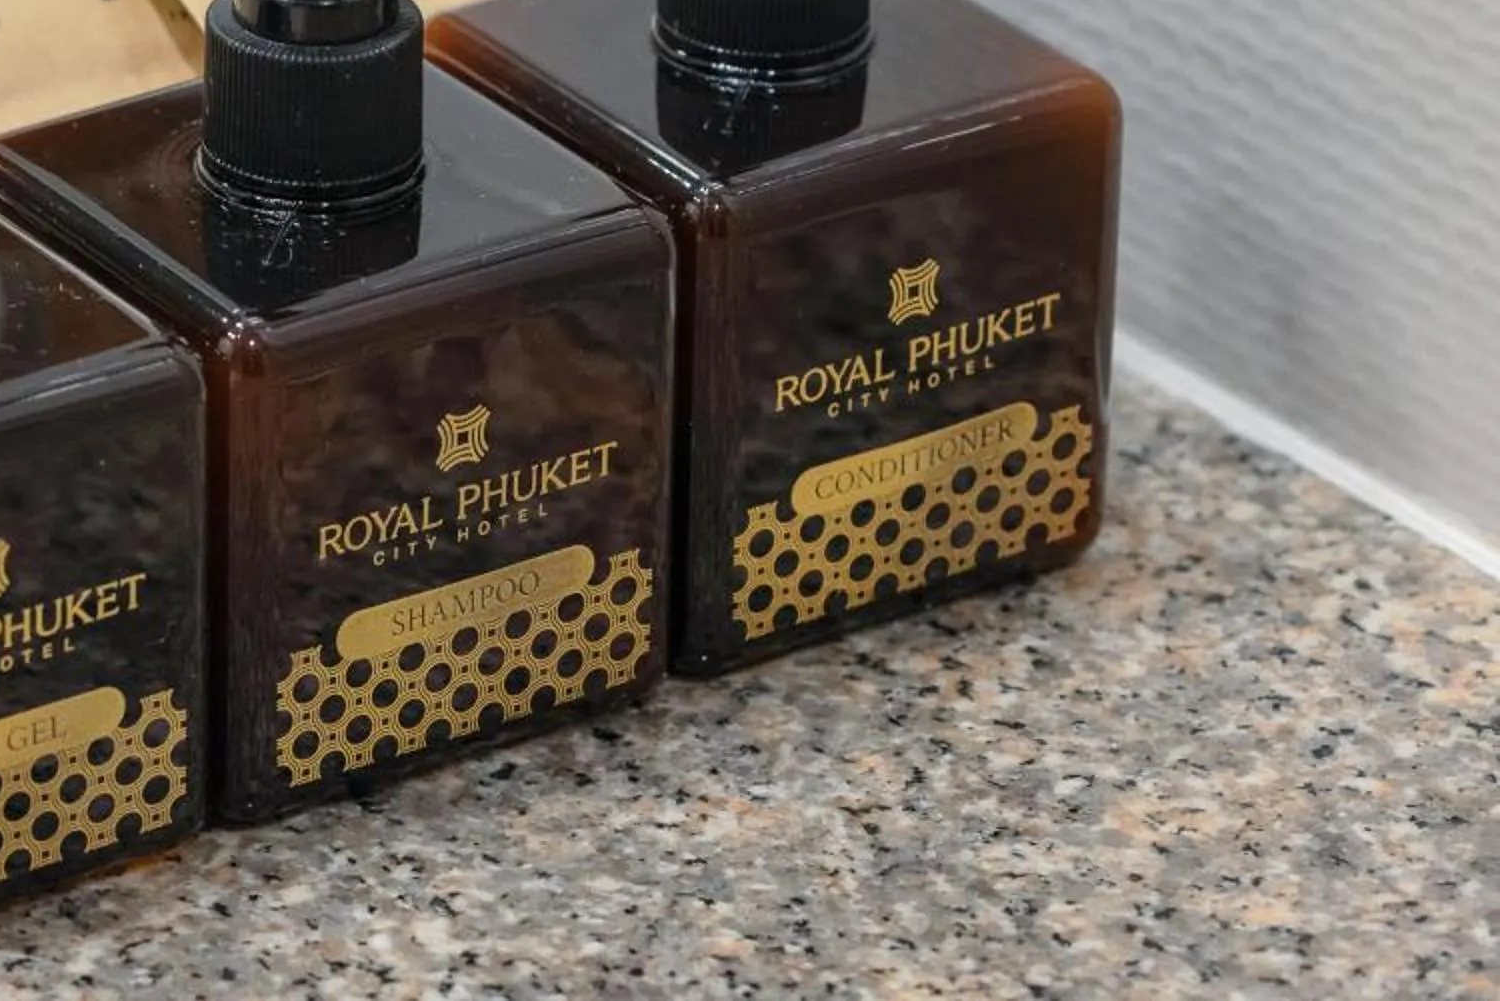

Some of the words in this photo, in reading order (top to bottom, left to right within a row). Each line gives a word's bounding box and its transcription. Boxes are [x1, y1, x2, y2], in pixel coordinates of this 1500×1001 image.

[774, 349, 897, 412] ROYAL
[908, 293, 1062, 372] PHUKET
[827, 388, 891, 419] CITY
[907, 355, 995, 395] HOTEL
[814, 415, 1016, 500] CONDITIONER
[318, 496, 443, 561] ROYAL
[456, 440, 618, 520] PHUKET
[372, 534, 438, 567] CITY
[456, 502, 549, 543] HOTEL
[391, 568, 541, 637] SHAMPOO
[5, 715, 68, 751] GEL
